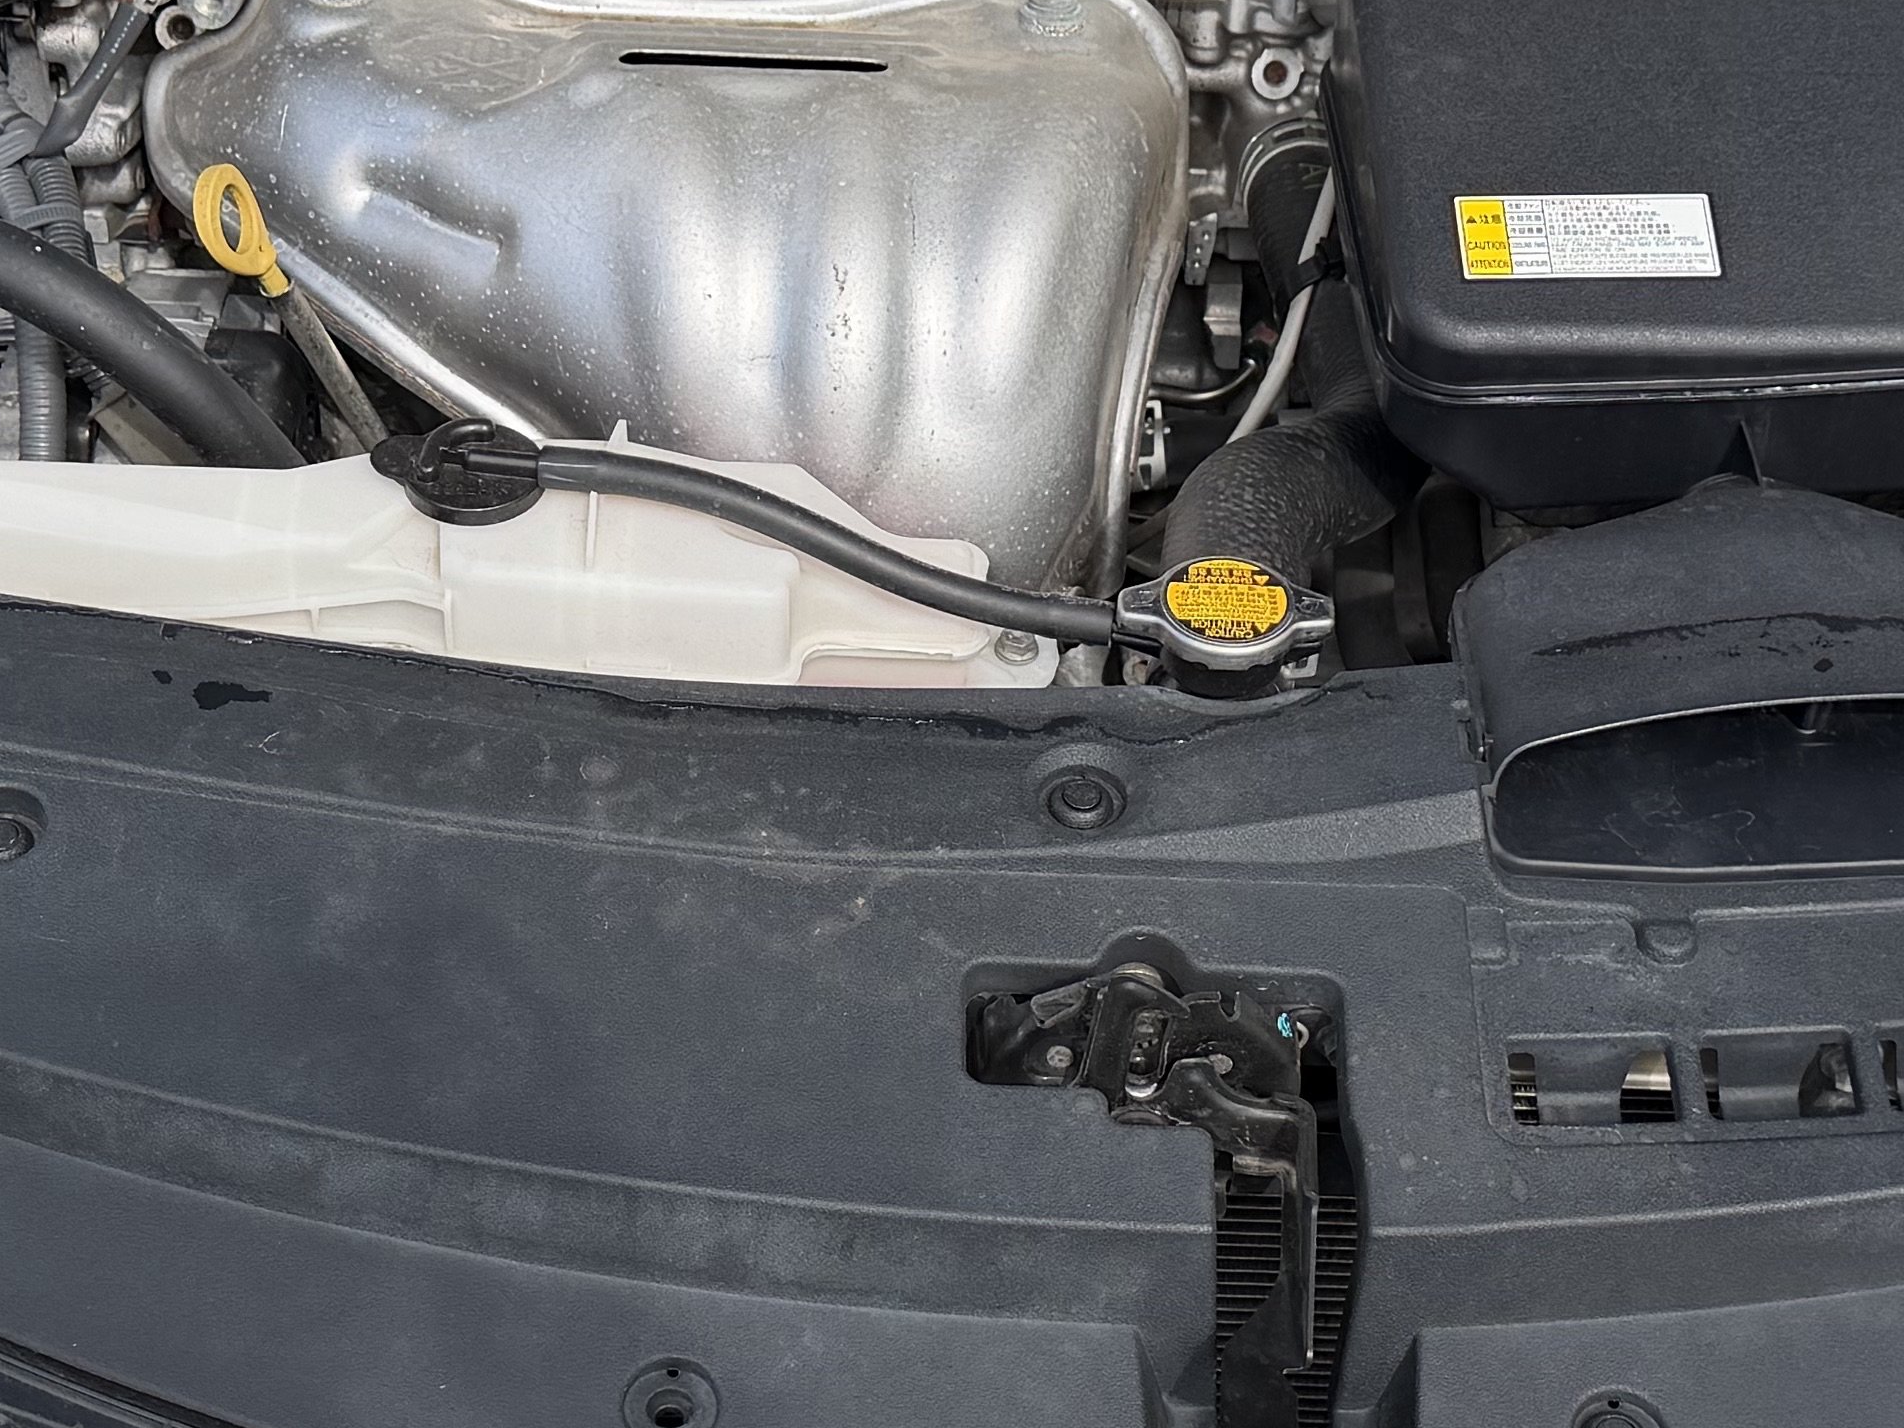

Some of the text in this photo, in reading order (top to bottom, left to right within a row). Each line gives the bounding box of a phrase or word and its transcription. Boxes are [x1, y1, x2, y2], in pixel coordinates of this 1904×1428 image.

[1467, 240, 1507, 251] CAUTION
[1191, 619, 1253, 630] ATTENTION
[1205, 627, 1254, 639] CAUTION
